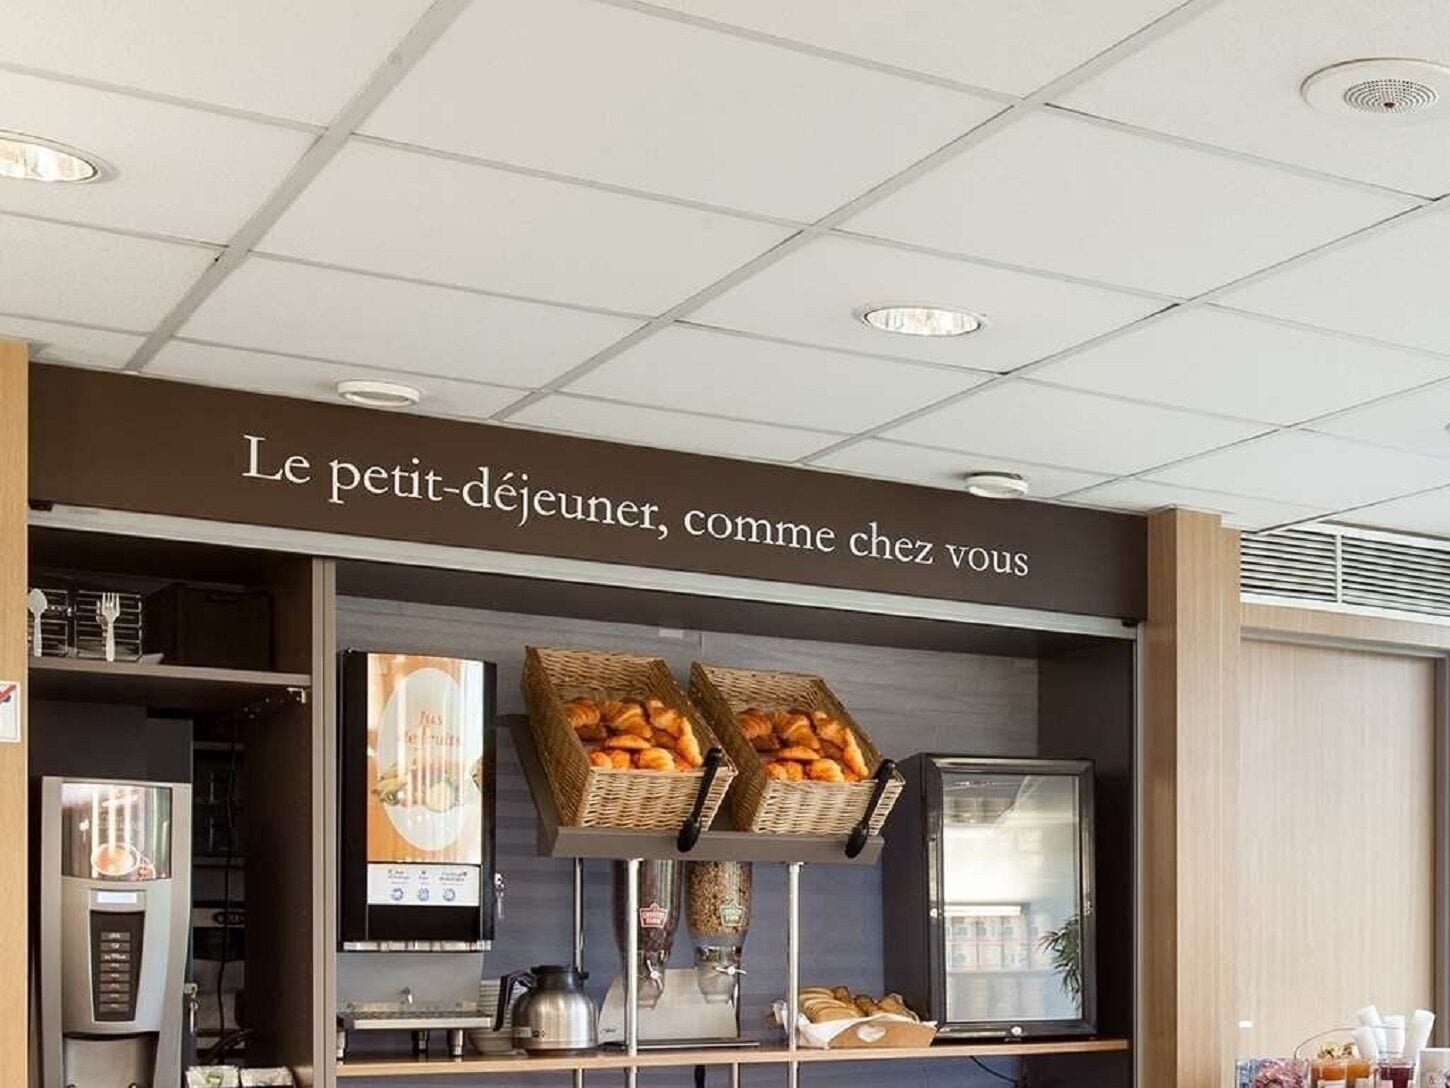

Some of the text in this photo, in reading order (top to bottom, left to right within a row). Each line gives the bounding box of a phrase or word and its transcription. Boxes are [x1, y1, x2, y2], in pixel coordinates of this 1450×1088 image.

[241, 433, 1030, 577] Le petit-déjeuner, comme chez vous
